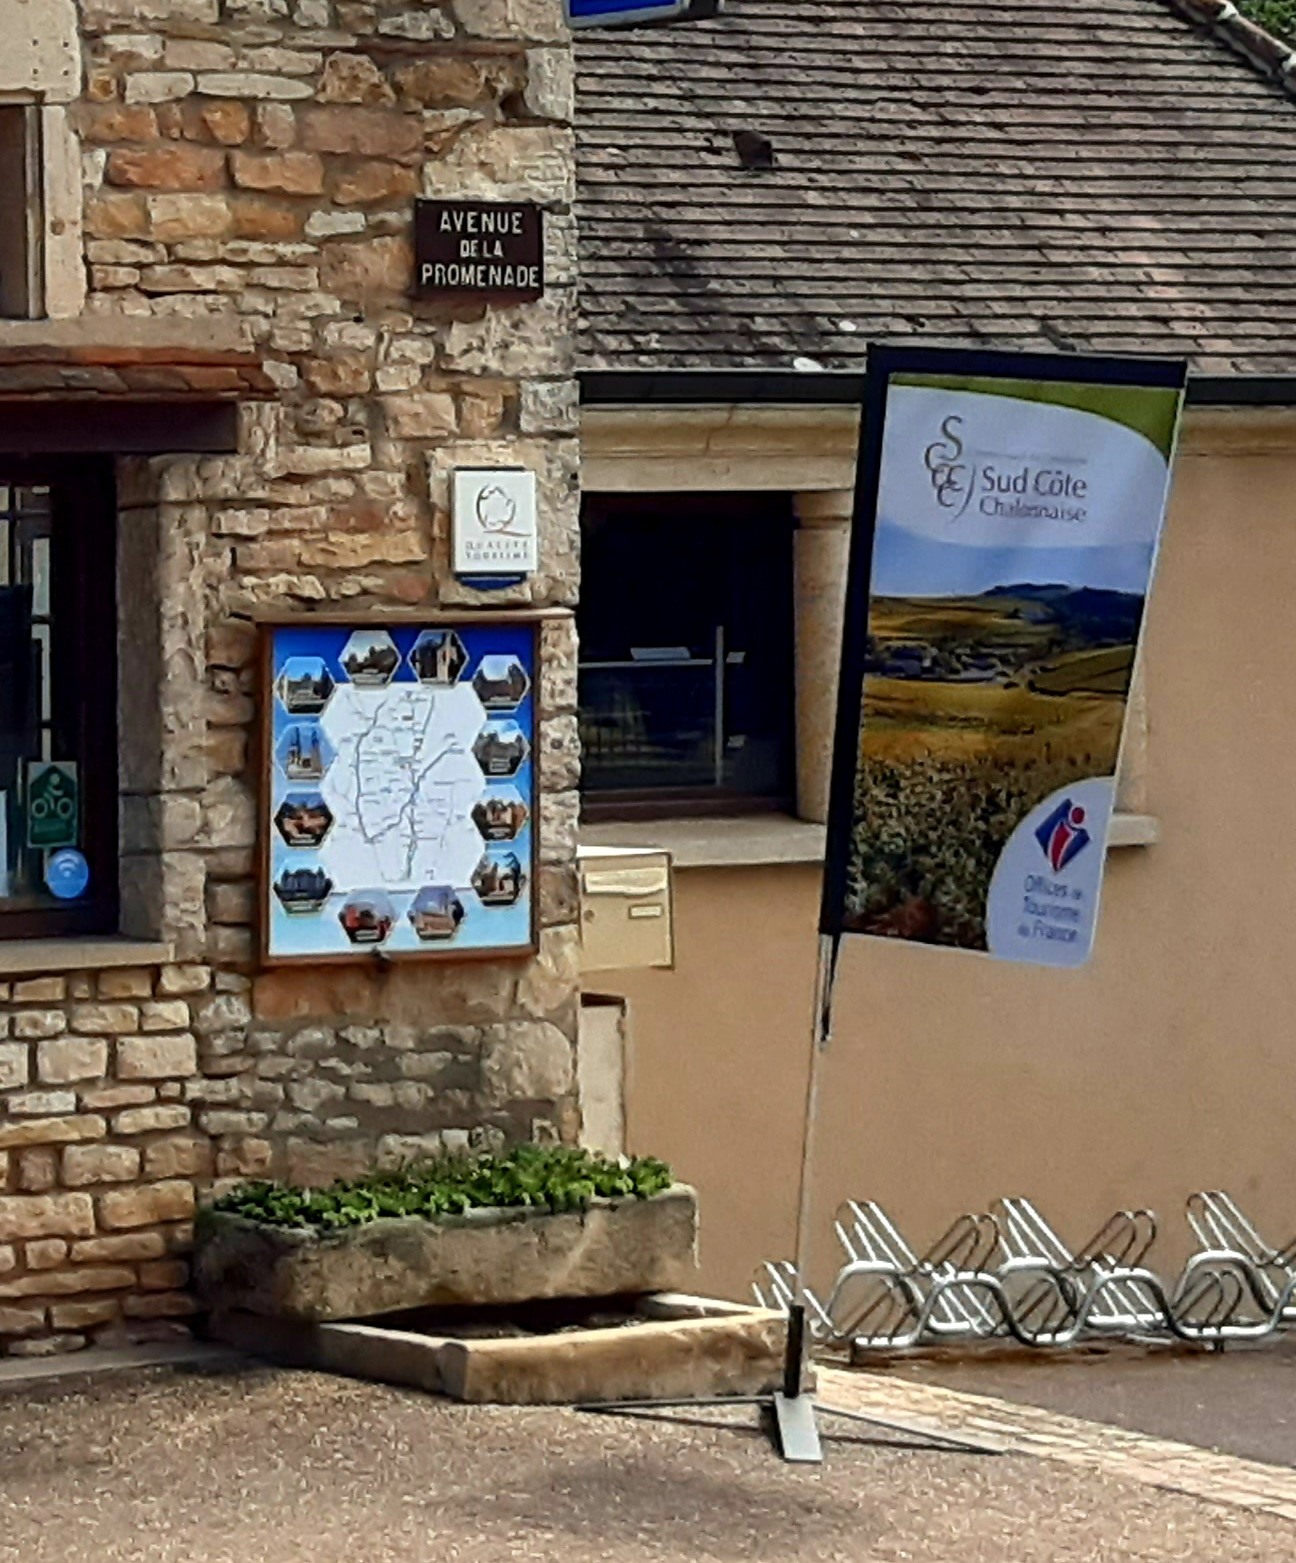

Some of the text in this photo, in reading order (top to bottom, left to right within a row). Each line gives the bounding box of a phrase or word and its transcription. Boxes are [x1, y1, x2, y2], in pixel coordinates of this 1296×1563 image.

[439, 210, 524, 234] AVENUE
[460, 239, 504, 258] DE LA
[421, 263, 541, 288] PROMENADE
[982, 466, 1088, 498] Sud Côte
[979, 495, 1087, 522] Chalonnaise
